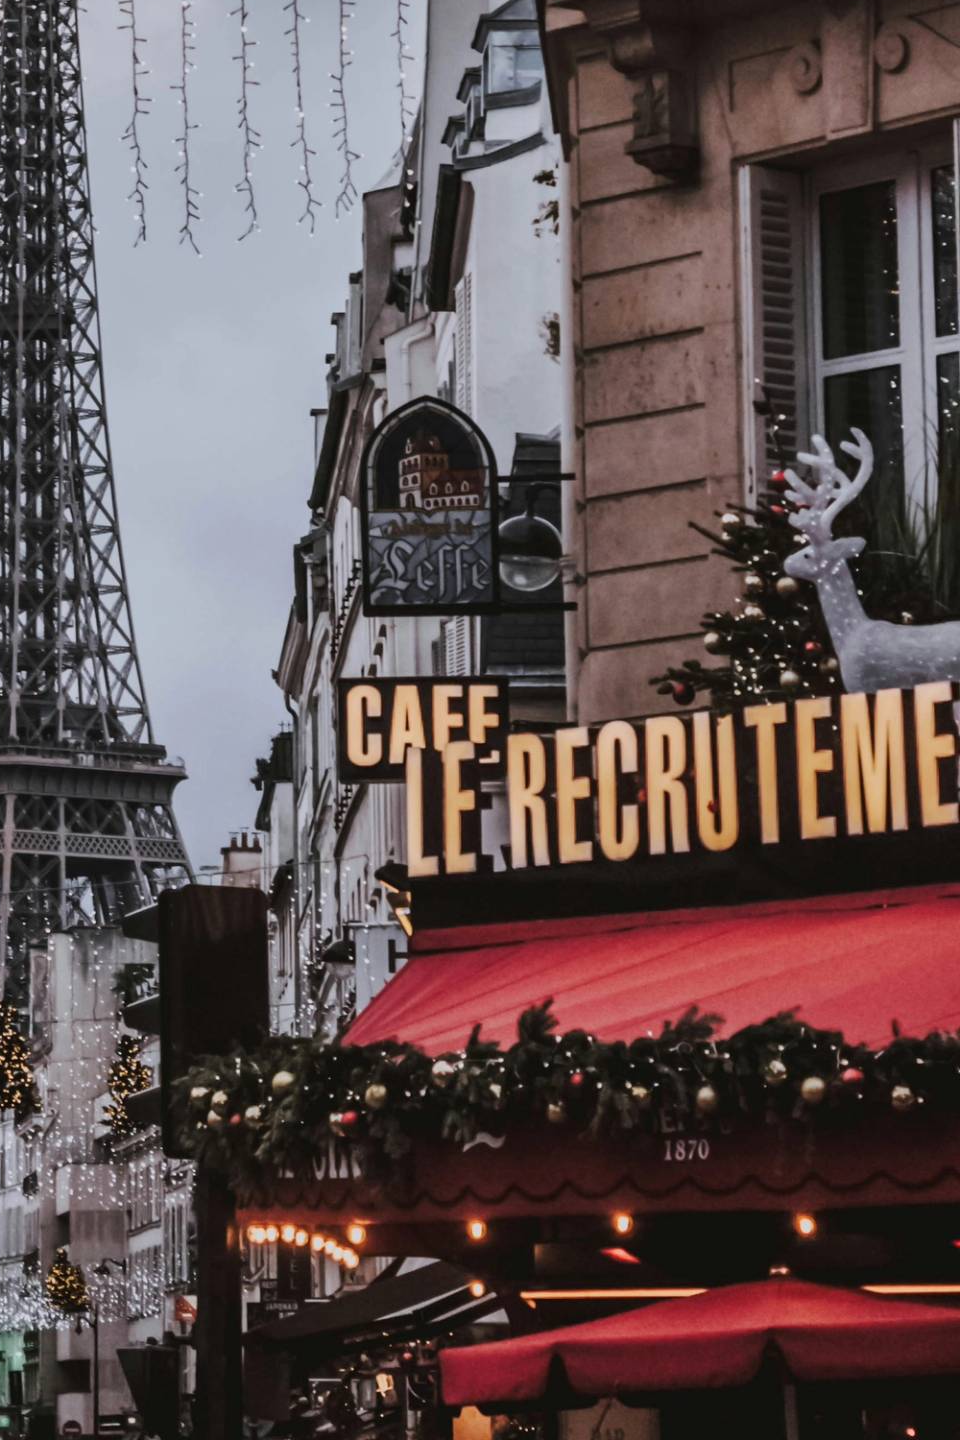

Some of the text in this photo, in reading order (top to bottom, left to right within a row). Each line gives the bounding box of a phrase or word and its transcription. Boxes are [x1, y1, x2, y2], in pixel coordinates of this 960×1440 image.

[370, 540, 490, 602] Leffe
[406, 680, 959, 878] LE RECRUTEME
[664, 1138, 710, 1161] 1870
